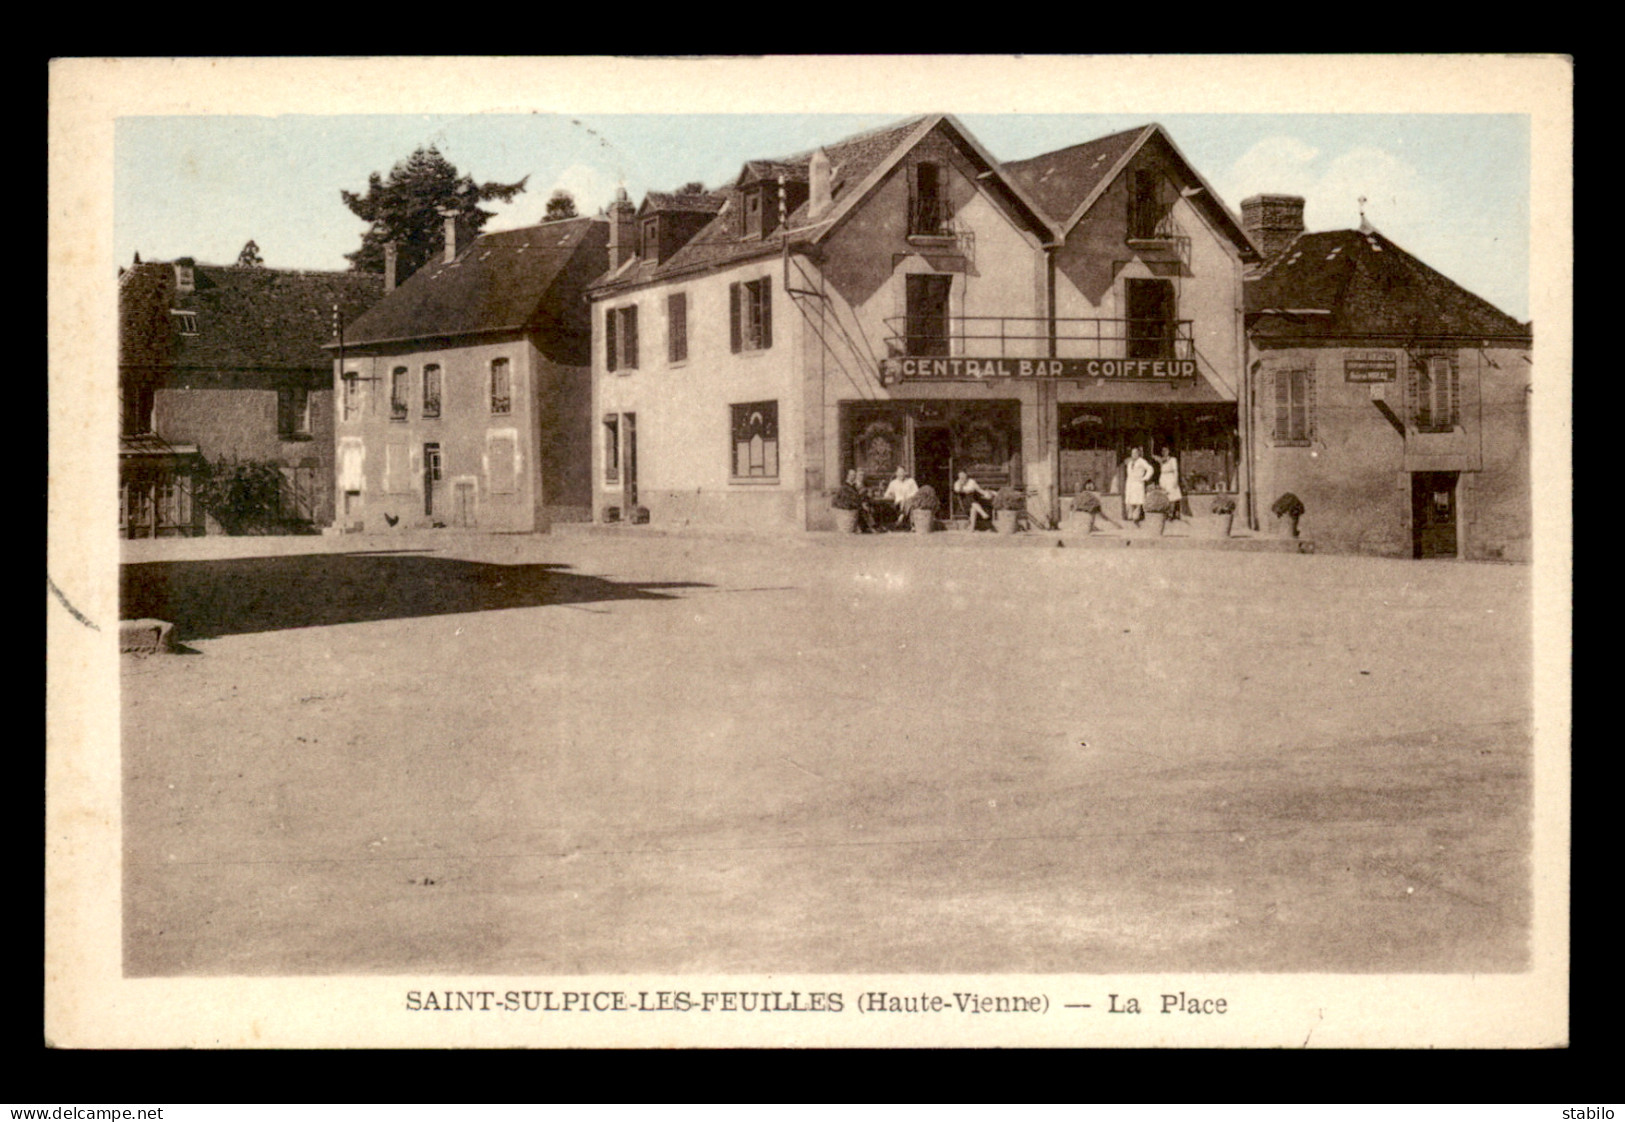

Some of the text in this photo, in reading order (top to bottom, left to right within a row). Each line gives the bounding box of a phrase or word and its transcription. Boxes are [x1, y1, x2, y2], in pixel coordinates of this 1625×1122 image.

[902, 360, 1194, 377] CENTRAL BAR COIFFEUR
